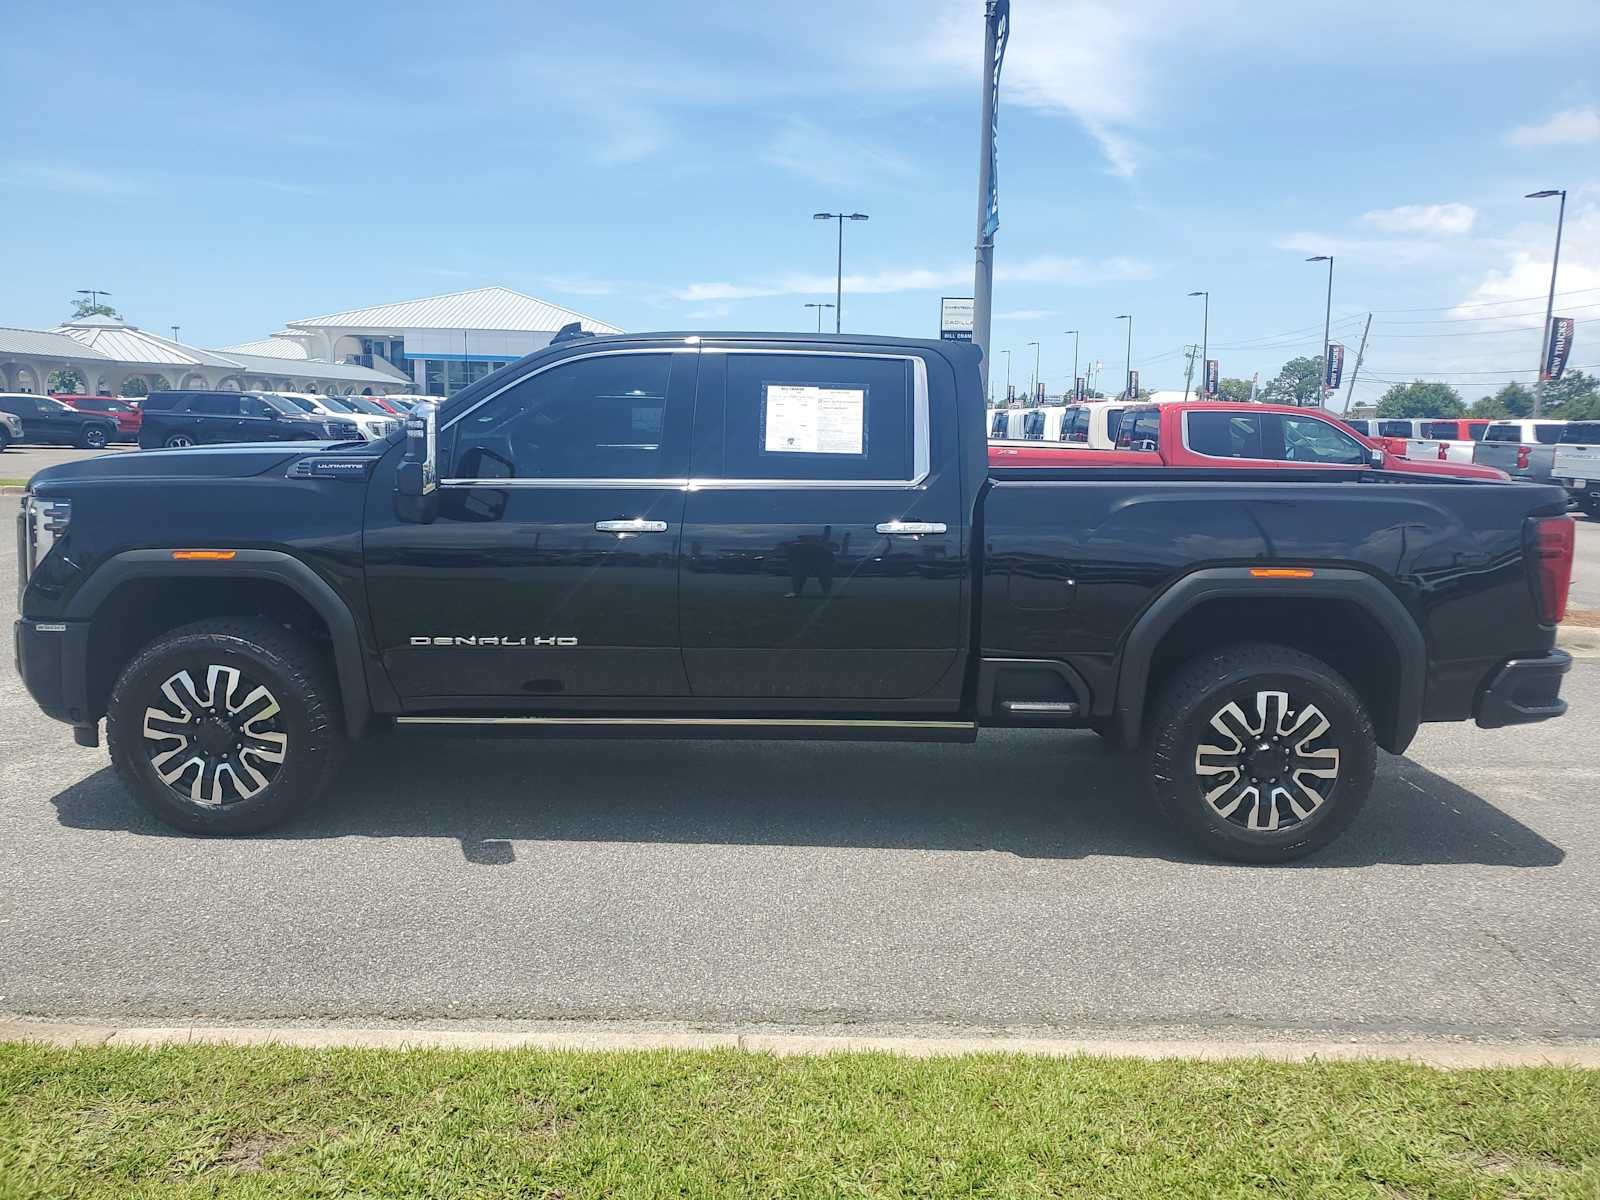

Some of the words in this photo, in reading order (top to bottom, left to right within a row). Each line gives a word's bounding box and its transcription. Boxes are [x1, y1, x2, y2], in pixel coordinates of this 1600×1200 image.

[1554, 320, 1568, 356] TRUCKS
[1550, 357, 1562, 377] NEW
[409, 635, 527, 646] DENALI
[533, 636, 579, 646] HD
